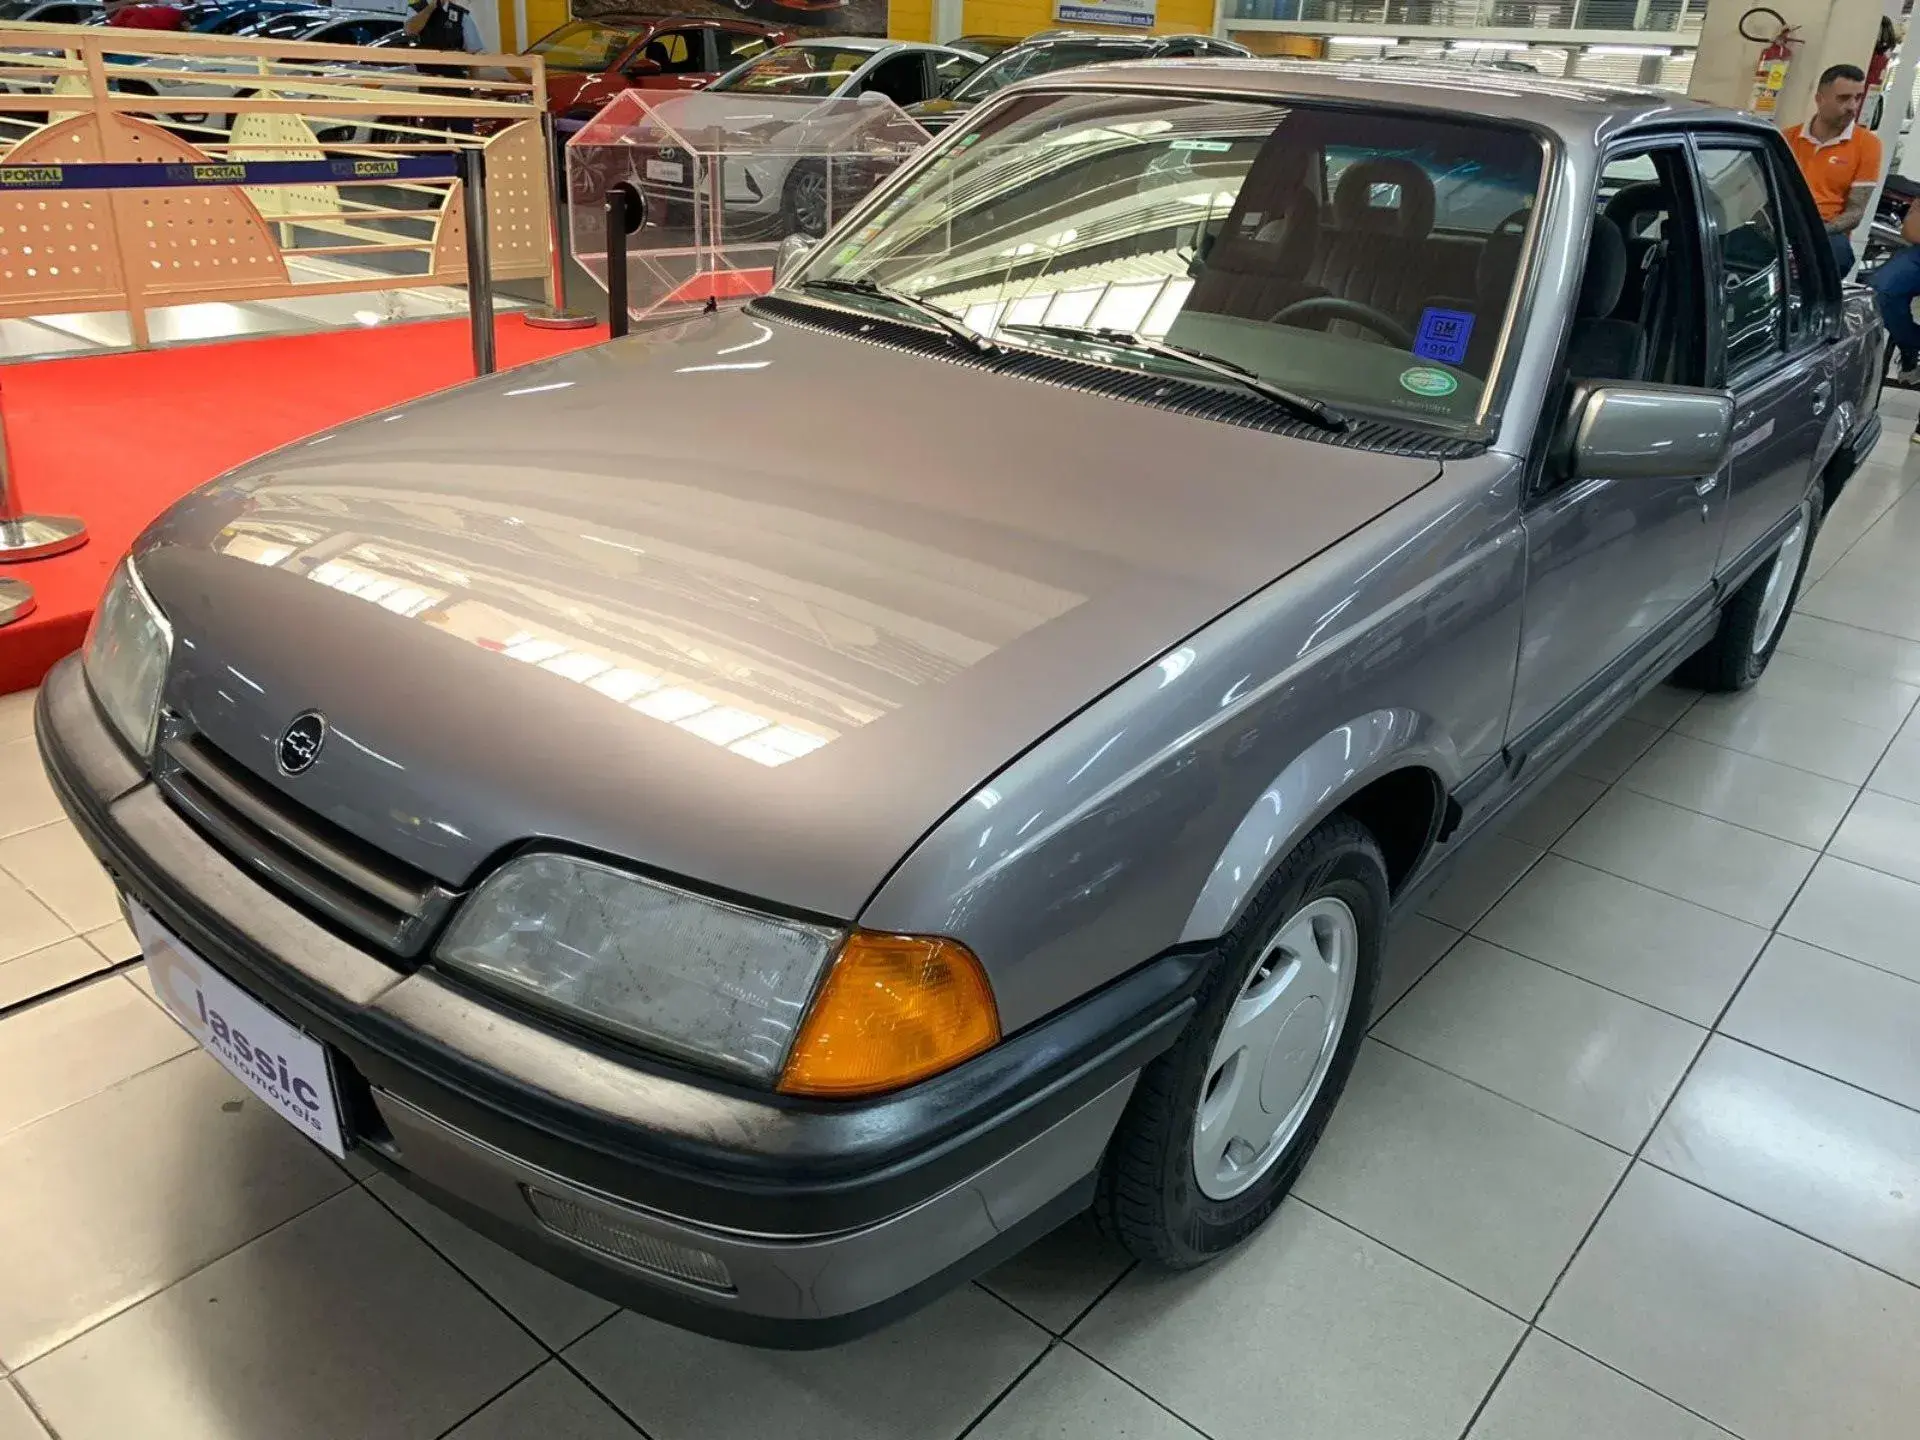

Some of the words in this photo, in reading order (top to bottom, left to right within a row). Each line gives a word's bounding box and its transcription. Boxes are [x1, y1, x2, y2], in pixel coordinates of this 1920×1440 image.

[196, 166, 243, 177] PORTAL
[356, 162, 396, 172] PORTAL
[3, 169, 61, 181] PORTAL
[1433, 320, 1458, 336] GM
[1423, 342, 1455, 356] 1990
[147, 940, 320, 1112] Classic
[210, 1036, 322, 1132] Automóveis
